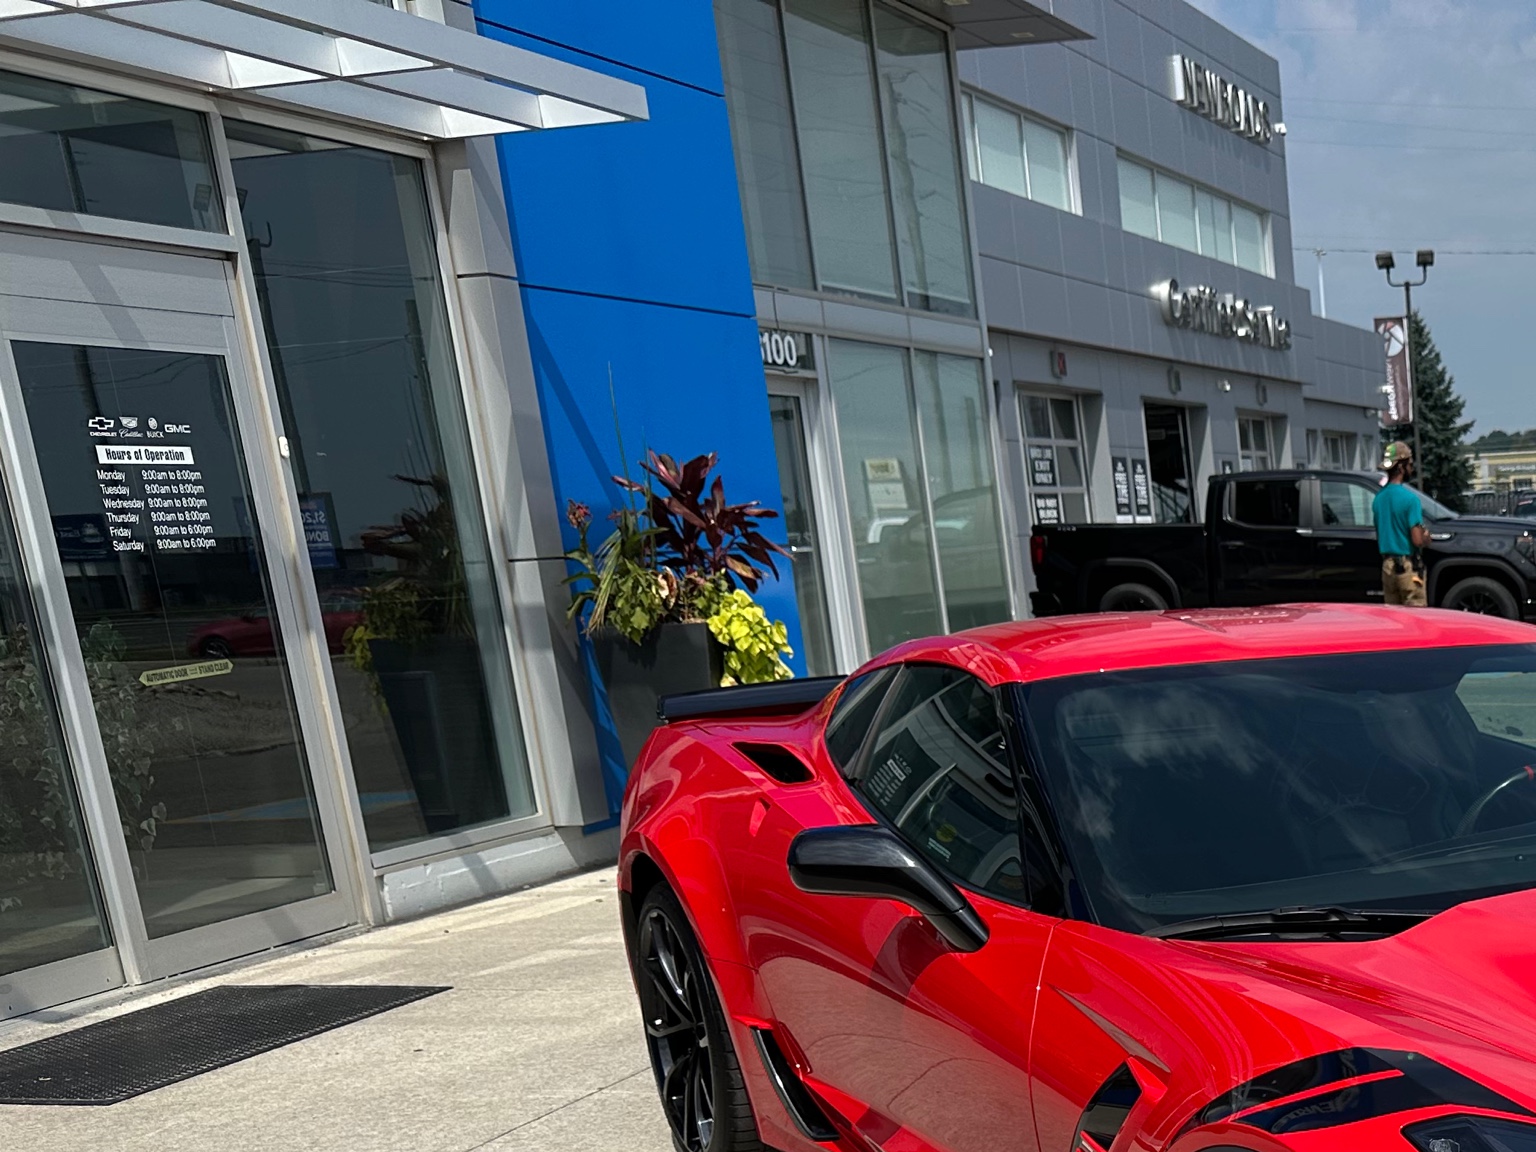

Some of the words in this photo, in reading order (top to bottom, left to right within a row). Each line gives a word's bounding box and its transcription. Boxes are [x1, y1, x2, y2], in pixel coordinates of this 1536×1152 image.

[759, 332, 797, 366] 100
[164, 424, 191, 434] GMC
[105, 448, 132, 460] Hours
[134, 449, 143, 460] of
[144, 449, 185, 462] Operation
[96, 470, 126, 482] Monday
[141, 470, 168, 480] 9:00am
[168, 470, 175, 480] to
[176, 470, 201, 482] 8:00pm
[100, 484, 130, 496] Tuesday
[144, 484, 171, 494] 9:00am
[171, 484, 178, 494] to
[179, 484, 204, 495] 8:00pm
[102, 498, 145, 510] Wednesday
[147, 498, 174, 508] 9:00am
[174, 498, 181, 508] to
[182, 498, 208, 509] 8:00pm
[106, 512, 139, 524] Thursday
[151, 512, 177, 522] 9:00am
[177, 511, 184, 521] to
[185, 511, 210, 522] 8:00pm
[109, 526, 132, 538] Friday
[154, 525, 180, 536] 9:00am
[180, 525, 187, 535] to
[188, 525, 213, 536] 6:00pm
[112, 540, 144, 552] Saturday
[156, 539, 183, 549] 9:00am
[183, 539, 190, 549] to
[191, 538, 216, 549] 6:00pm
[146, 671, 174, 682] AUTOMATIC
[174, 668, 188, 678] DOOR
[198, 664, 214, 674] STAND
[214, 662, 229, 671] CLEAR
